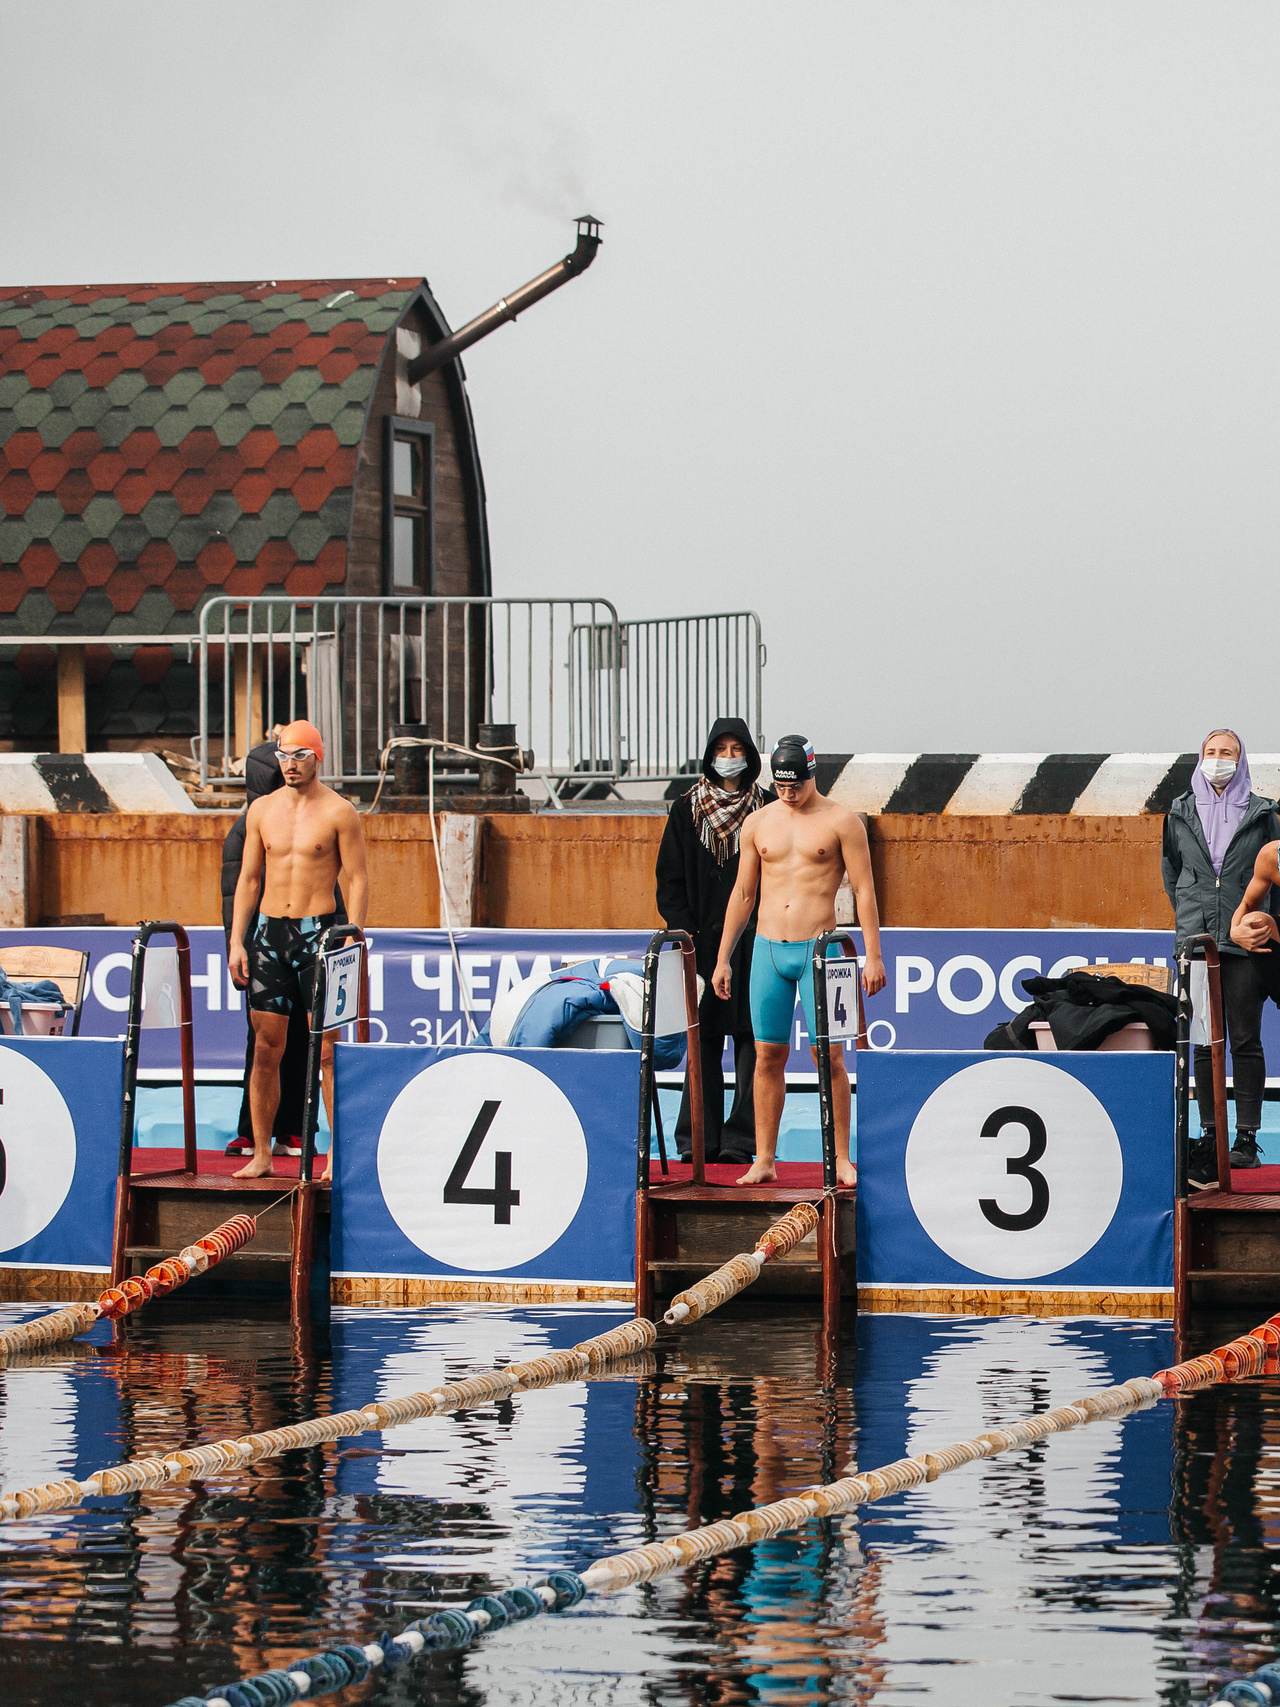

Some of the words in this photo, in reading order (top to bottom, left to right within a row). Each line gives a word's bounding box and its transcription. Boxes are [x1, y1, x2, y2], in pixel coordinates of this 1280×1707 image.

[335, 973, 348, 1017] 5
[834, 986, 847, 1028] 4
[443, 1100, 520, 1225] 4
[978, 1106, 1050, 1231] 3
